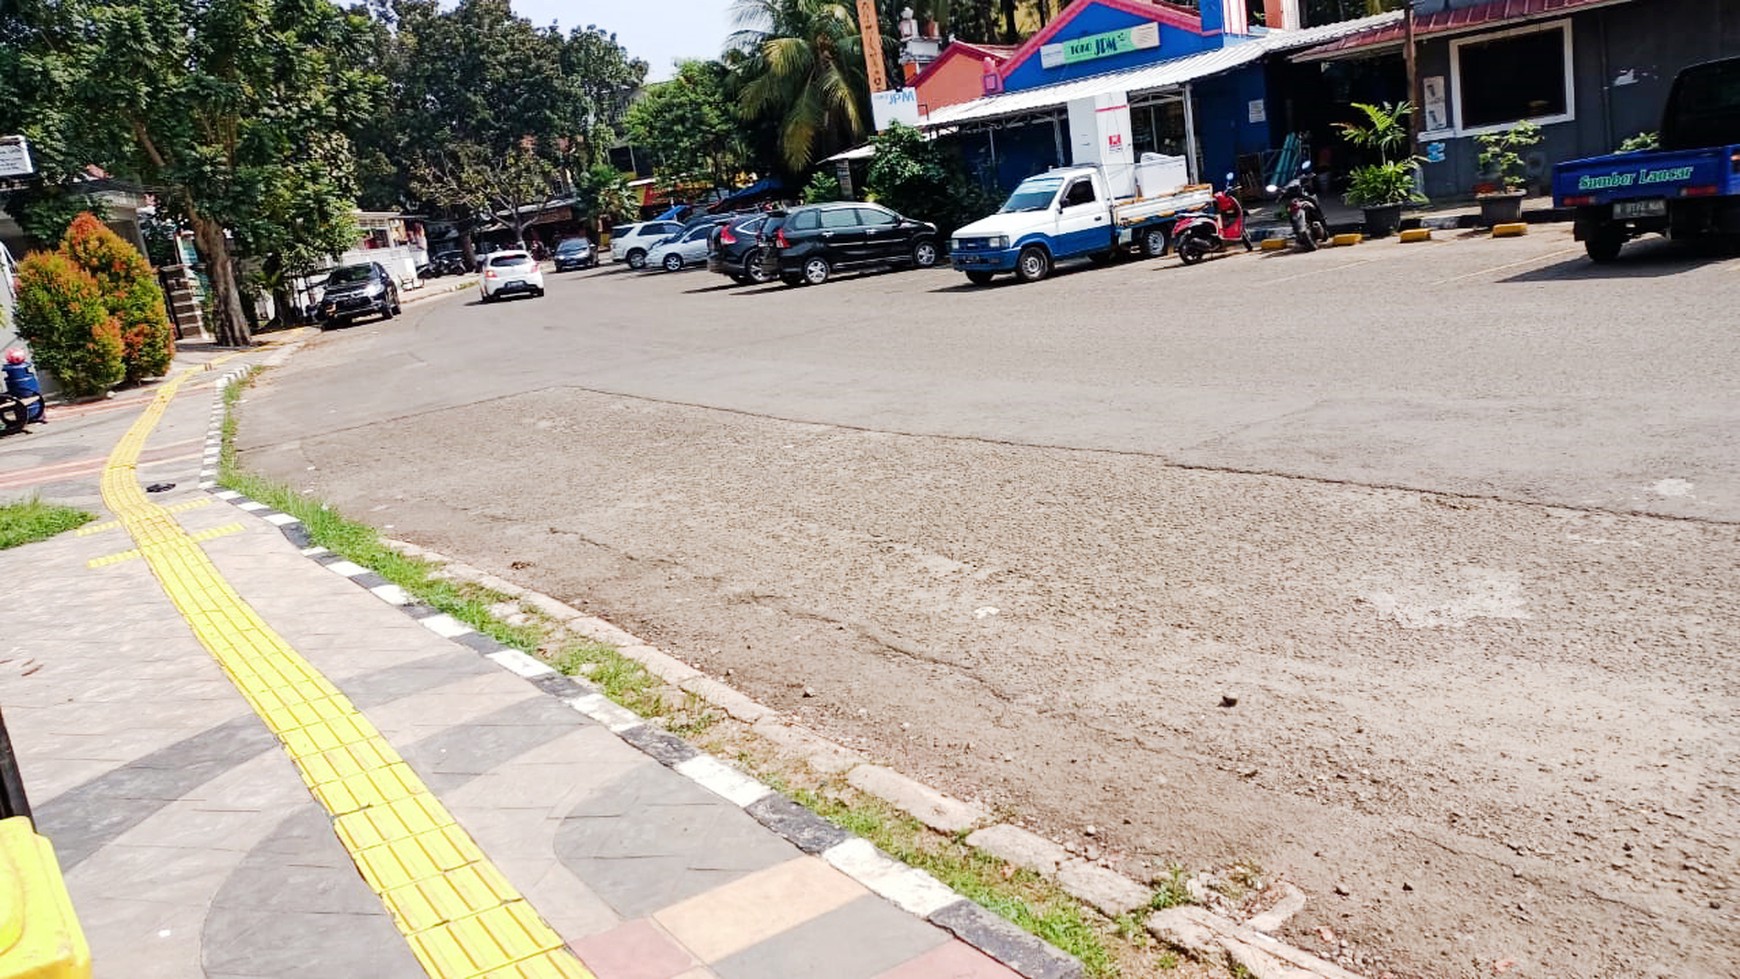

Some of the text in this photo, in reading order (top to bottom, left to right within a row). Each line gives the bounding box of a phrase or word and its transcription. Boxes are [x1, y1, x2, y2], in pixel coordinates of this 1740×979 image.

[1094, 37, 1117, 56] JPM
[889, 91, 915, 105] JPM
[1638, 166, 1694, 184] Lancar
